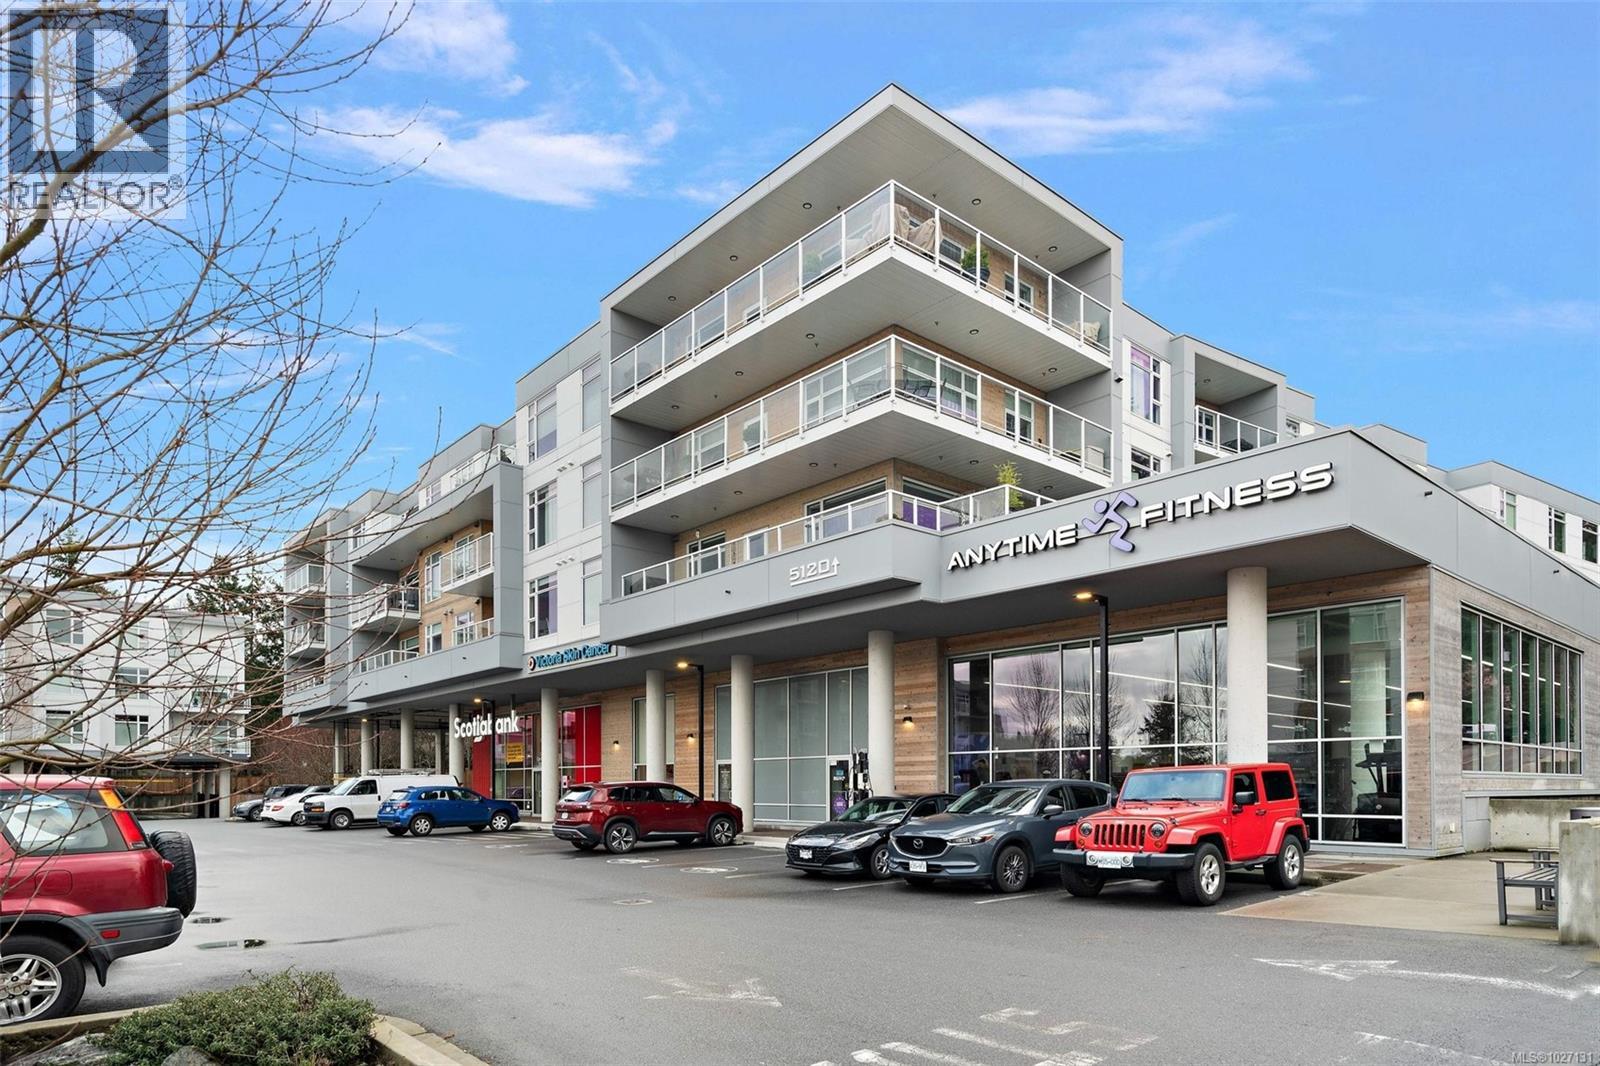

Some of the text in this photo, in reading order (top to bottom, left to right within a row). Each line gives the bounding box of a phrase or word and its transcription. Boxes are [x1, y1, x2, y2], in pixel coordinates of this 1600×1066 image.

[947, 462, 1333, 570] ANYTIME FITNESS
[789, 559, 830, 581] 5120
[536, 643, 612, 668] Victoria Skin Cancer
[454, 710, 519, 740] Scotiabank
